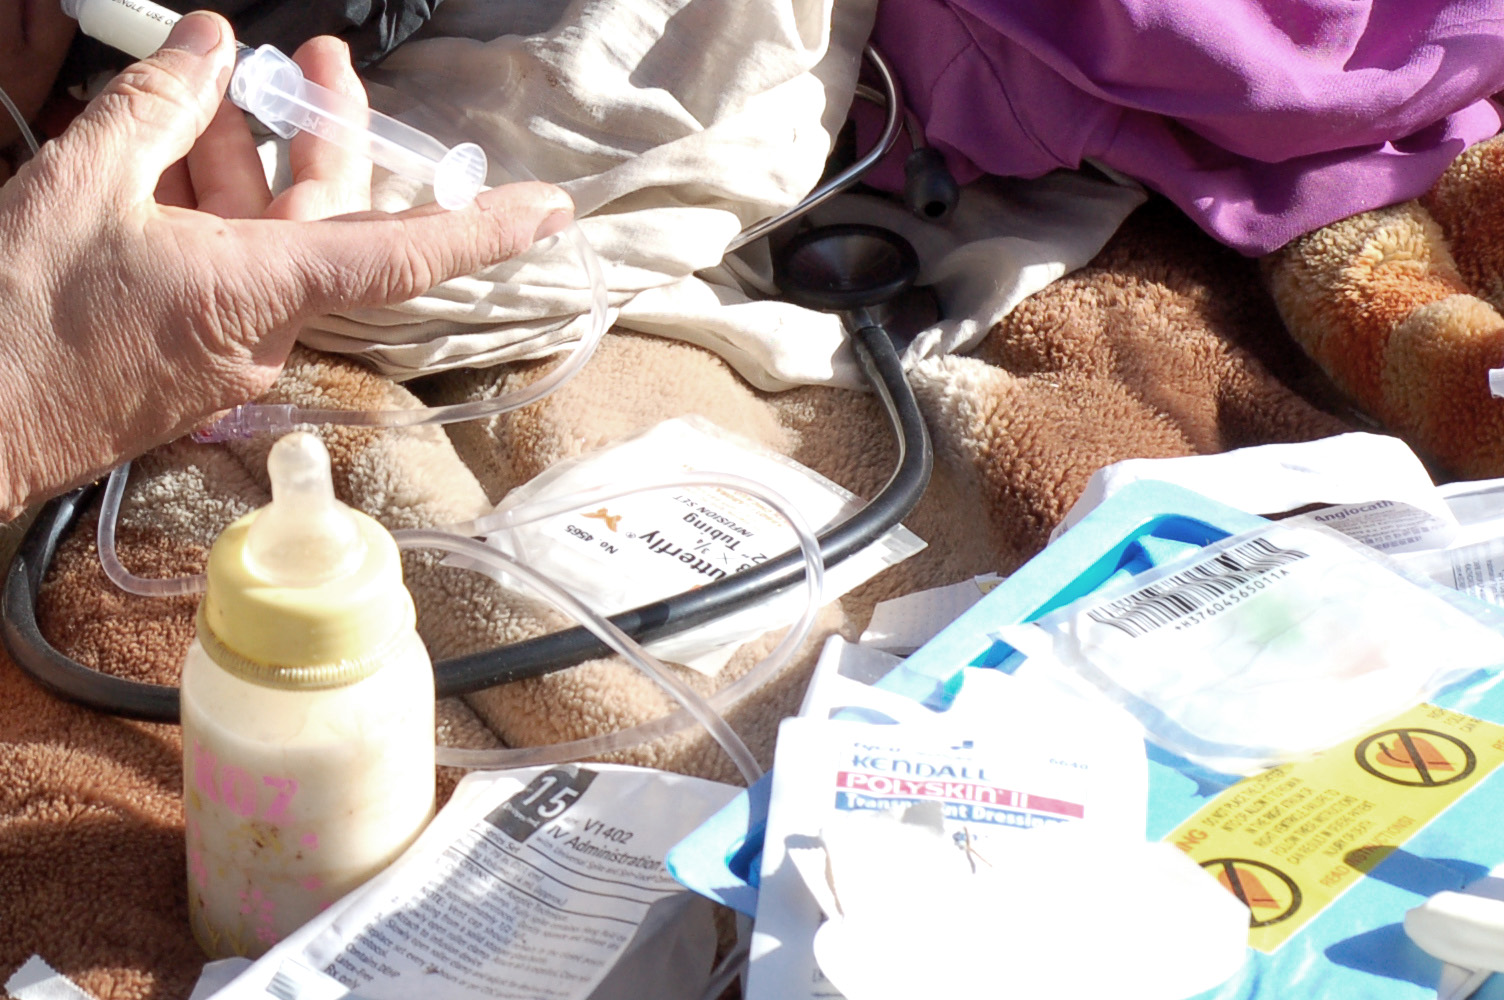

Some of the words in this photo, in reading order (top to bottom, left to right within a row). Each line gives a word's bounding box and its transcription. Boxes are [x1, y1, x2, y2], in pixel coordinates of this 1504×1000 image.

[146, 11, 163, 22] USE
[564, 524, 595, 542] 4565
[683, 512, 740, 551] Tubing
[599, 538, 619, 554] No.
[852, 755, 992, 780] KENDALL
[522, 775, 579, 818] 15
[583, 817, 635, 845] V1402
[546, 825, 565, 841] IV
[564, 832, 662, 870] Administration
[1319, 857, 1351, 889] READ
